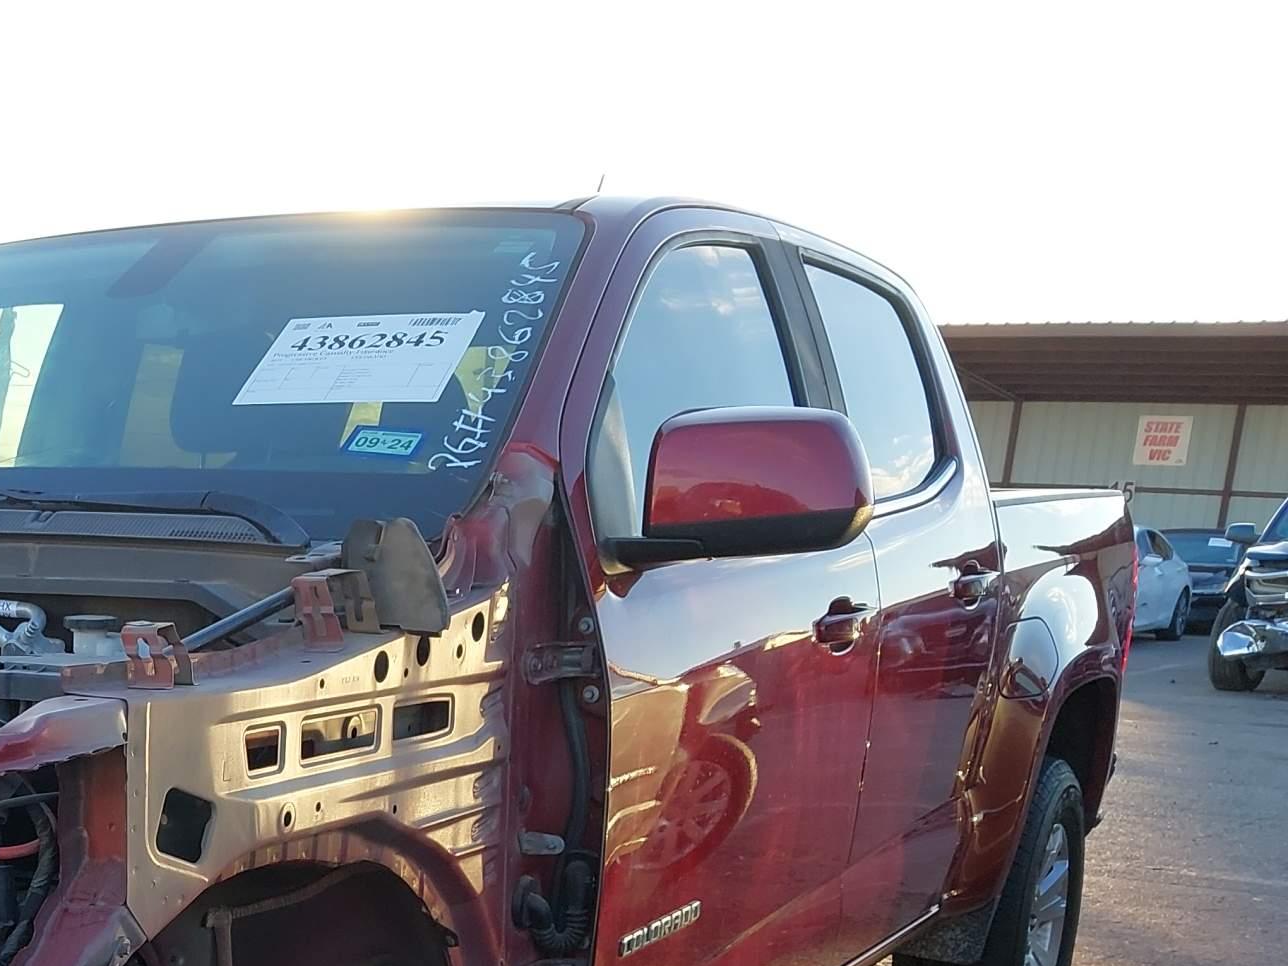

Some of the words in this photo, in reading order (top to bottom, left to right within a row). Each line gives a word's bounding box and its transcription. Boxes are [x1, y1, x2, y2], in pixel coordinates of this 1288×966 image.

[290, 330, 449, 351] 43862845
[1143, 421, 1184, 434] STATE
[355, 436, 380, 448] 09
[387, 438, 414, 450] 24
[1143, 434, 1180, 447] FARM
[1148, 449, 1172, 461] VIC
[620, 900, 701, 958] COLORADO
